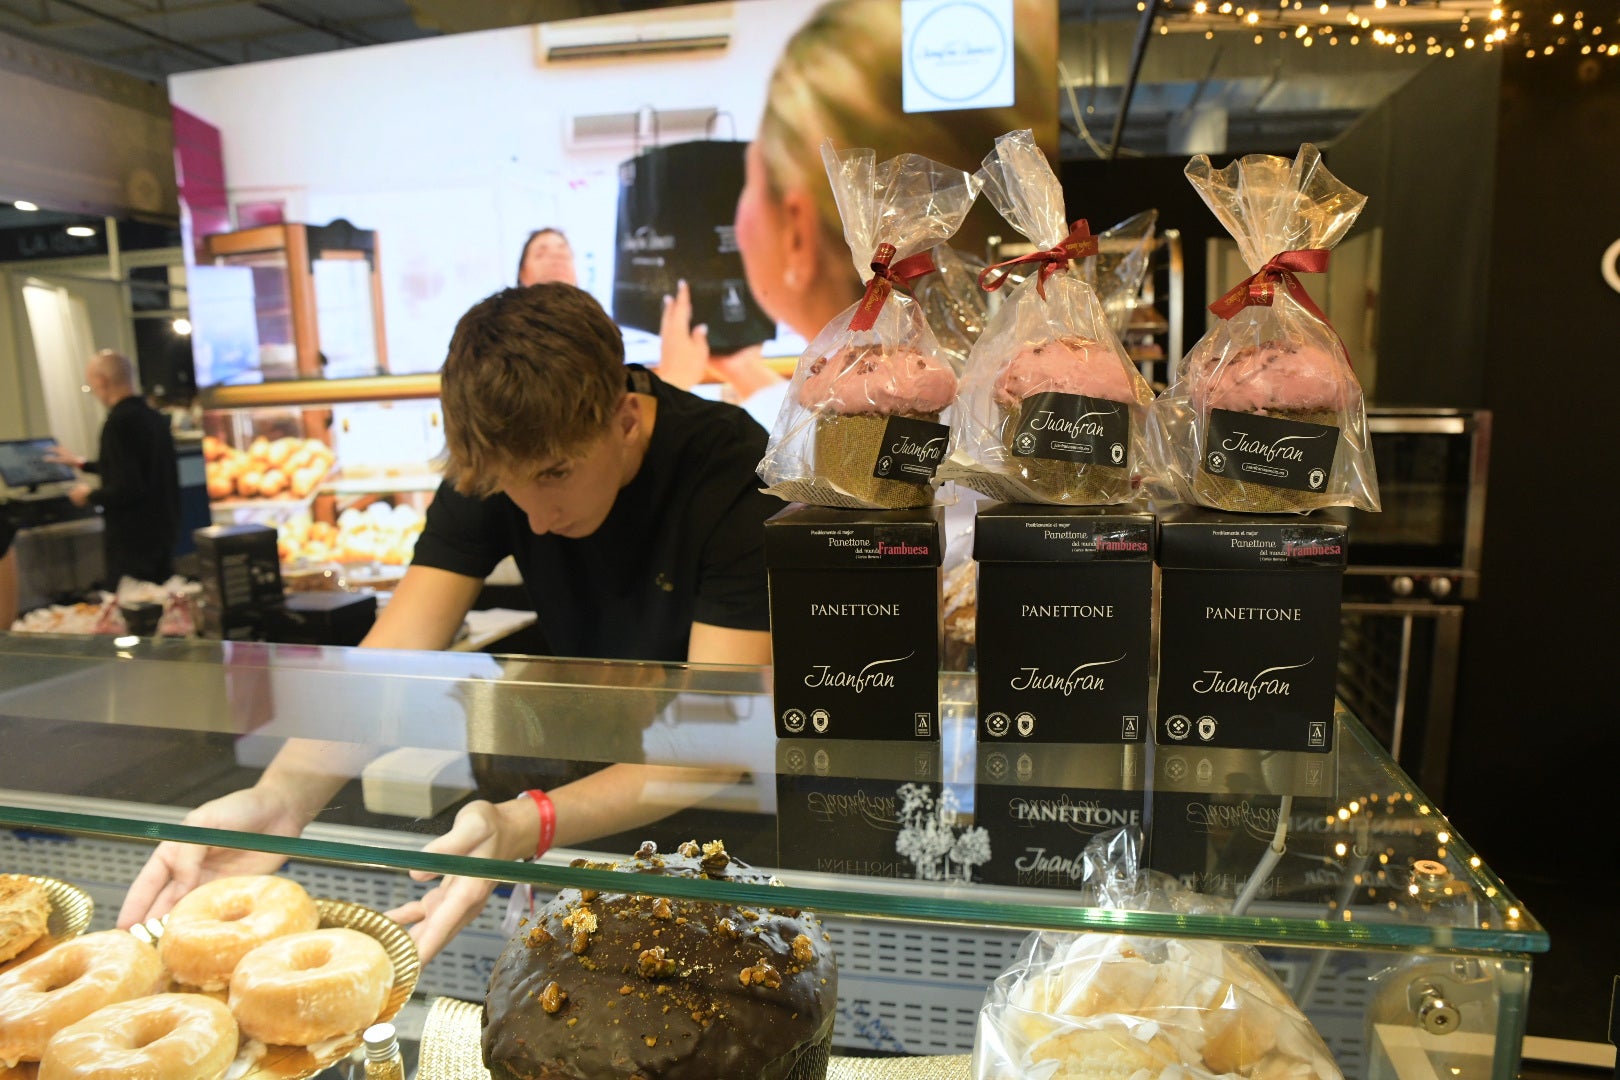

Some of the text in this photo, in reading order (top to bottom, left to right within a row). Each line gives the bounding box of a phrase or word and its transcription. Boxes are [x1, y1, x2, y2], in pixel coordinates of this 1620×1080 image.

[1030, 407, 1120, 439] Juanfran
[891, 435, 946, 463] Juanfra
[1222, 430, 1328, 462] Juanfran
[828, 537, 871, 547] Panettone
[1044, 530, 1088, 540] Panettone
[1096, 535, 1148, 551] Frambuesa
[878, 541, 929, 555] Frambuesa
[1231, 539, 1277, 548] Panettone
[1287, 543, 1341, 557] Frambuesa
[811, 604, 900, 616] PANETTONE
[1022, 605, 1114, 618] PANETTONE
[1206, 607, 1301, 621] PANETTONE
[804, 650, 915, 694] Juanfran
[1010, 652, 1127, 697] Juanfran
[1192, 655, 1315, 700] Juanfran
[1018, 803, 1140, 826] PANETTONE
[1014, 847, 1084, 881] Juanf
